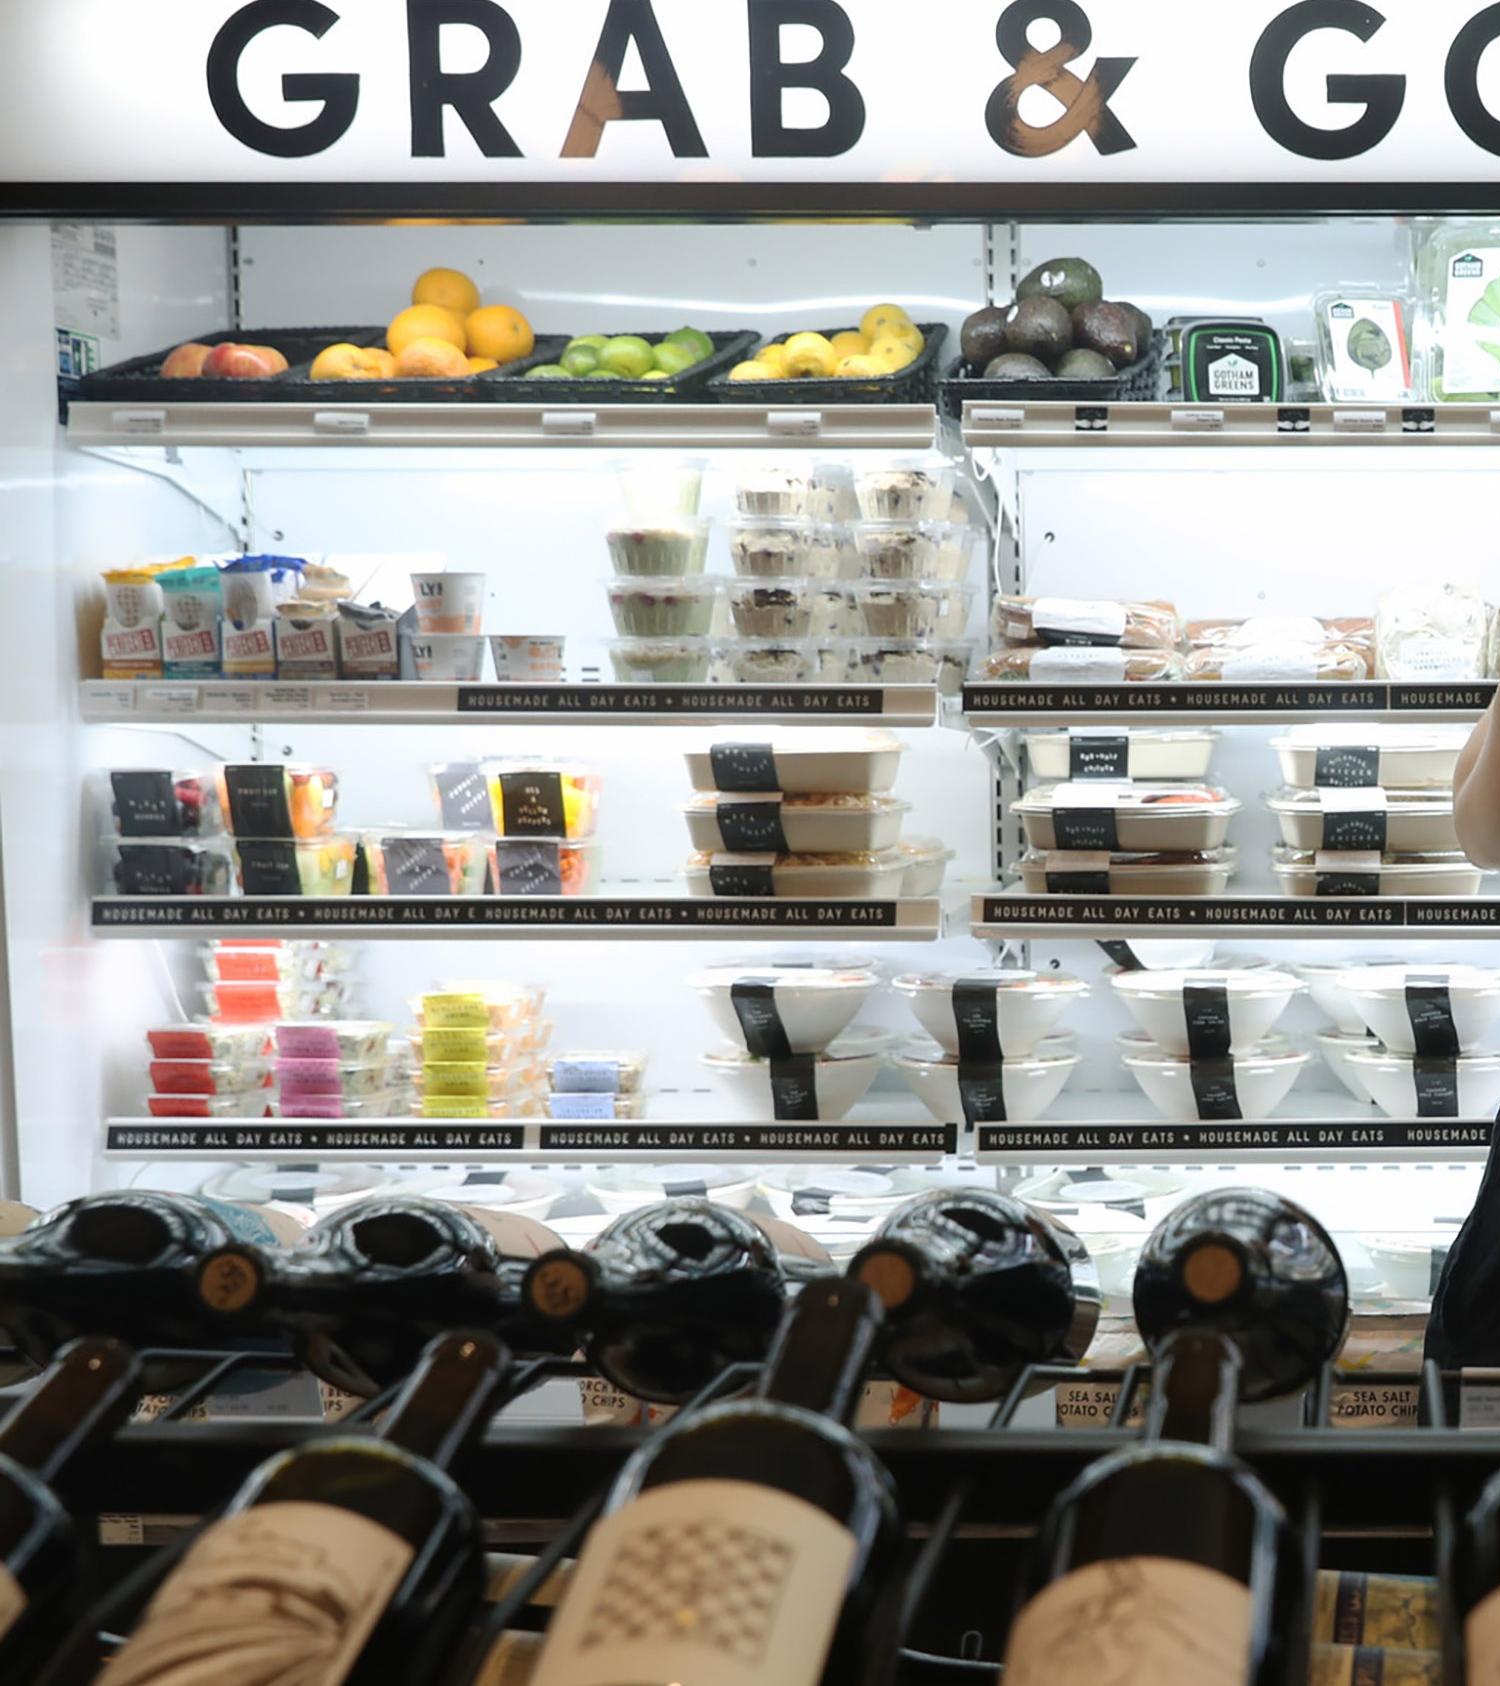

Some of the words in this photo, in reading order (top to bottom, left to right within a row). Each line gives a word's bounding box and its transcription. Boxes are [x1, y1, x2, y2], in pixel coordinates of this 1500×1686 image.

[206, 0, 867, 158] GRAB
[984, 0, 1138, 158] &
[1214, 370, 1254, 380] GOTHAM
[1214, 381, 1254, 391] GREENS
[469, 696, 548, 706] HOUSEMADE
[558, 696, 580, 706] ALL
[591, 696, 614, 706] DAY
[624, 695, 656, 706] EATS
[683, 696, 761, 707] HOUSEMADE
[771, 696, 794, 707] ALL
[804, 696, 828, 707] DAY
[837, 696, 869, 707] EATS
[973, 695, 1052, 706] HOUSEMADE
[1063, 695, 1085, 705] ALL
[1095, 695, 1119, 705] DAY
[1129, 694, 1160, 705] EATS
[1187, 693, 1266, 704] HOUSEMADE
[1276, 693, 1298, 704] ALL
[1308, 693, 1332, 704] DAY
[1342, 693, 1373, 704] EATS
[1402, 693, 1480, 704] HOUSEMADE
[103, 909, 181, 920] HOUSEMADE
[192, 909, 213, 920] ALL
[224, 909, 248, 919] DAY
[257, 908, 289, 919] EATS
[315, 908, 393, 919] HOUSEMADE
[403, 908, 425, 919] ALL
[435, 908, 459, 918] DAY
[485, 908, 564, 918] HOUSEMADE
[574, 909, 596, 919] ALL
[606, 908, 630, 919] DAY
[640, 908, 671, 919] EATS
[698, 908, 776, 919] HOUSEMADE
[786, 909, 807, 919] ALL
[818, 908, 842, 919] DAY
[851, 908, 882, 919] EATS
[994, 908, 1072, 918] HOUSEMADE
[1083, 908, 1104, 918] ALL
[1115, 907, 1139, 918] DAY
[1148, 908, 1180, 918] EATS
[1206, 908, 1284, 919] HOUSEMADE
[1295, 909, 1316, 920] ALL
[1327, 909, 1350, 920] DAY
[1360, 909, 1391, 920] EATS
[1418, 909, 1496, 920] HOUSEMADE
[117, 1133, 196, 1144] HOUSEMADE
[205, 1134, 227, 1144] ALL
[236, 1133, 260, 1144] DAY
[269, 1133, 302, 1145] EATS
[327, 1133, 405, 1145] HOUSEMADE
[414, 1134, 437, 1144] ALL
[446, 1134, 470, 1144] DAY
[479, 1133, 511, 1144] EATS
[550, 1133, 628, 1144] HOUSEMADE
[638, 1134, 660, 1144] ALL
[670, 1133, 693, 1144] DAY
[703, 1133, 734, 1144] EATS
[760, 1133, 838, 1144] HOUSEMADE
[848, 1134, 869, 1144] ALL
[880, 1134, 903, 1144] DAY
[913, 1133, 944, 1144] EATS
[990, 1133, 1068, 1144] HOUSEMADE
[1077, 1133, 1099, 1144] ALL
[1109, 1133, 1133, 1144] DAY
[1142, 1132, 1174, 1143] EATS
[1200, 1131, 1278, 1142] HOUSEMADE
[1288, 1131, 1309, 1142] ALL
[1319, 1131, 1343, 1142] DAY
[1352, 1131, 1383, 1142] EATS
[1407, 1130, 1487, 1141] HOUSEMADE
[1068, 1391, 1089, 1402] SEA
[1353, 1391, 1376, 1402] SEA
[1382, 1391, 1411, 1402] SALT
[1337, 1405, 1386, 1416] POTATO
